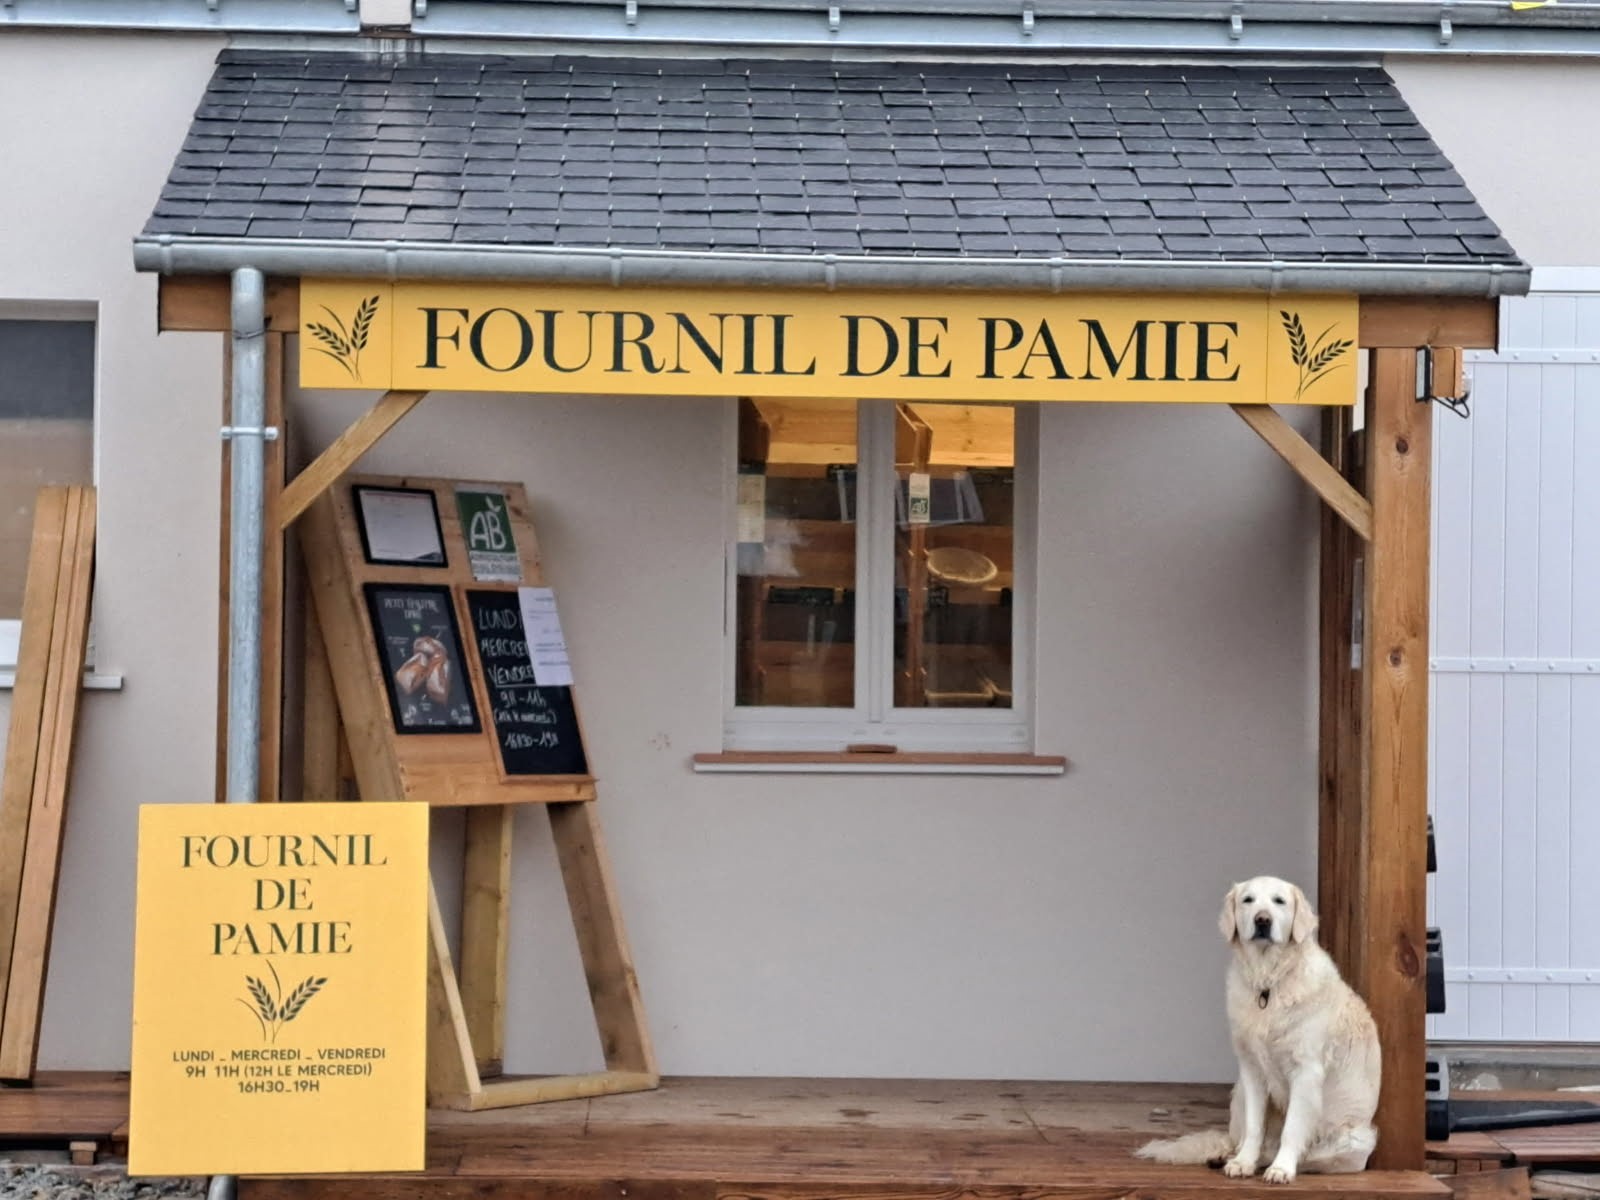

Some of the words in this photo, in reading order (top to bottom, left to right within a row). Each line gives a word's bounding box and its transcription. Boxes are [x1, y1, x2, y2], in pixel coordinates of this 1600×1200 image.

[416, 306, 816, 375] FOURNIL
[838, 315, 952, 378] DE
[976, 317, 1241, 382] PAMIE
[470, 511, 506, 549] AB
[480, 639, 529, 656] MERCRE
[487, 664, 535, 686] VENDRE
[183, 834, 389, 869] FOURNIL
[254, 879, 313, 912] DE
[211, 921, 353, 956] PAMIE
[172, 1051, 215, 1062] LUNDI
[231, 1049, 301, 1061] MERCREDI
[317, 1048, 386, 1060] VENDREDI
[185, 1066, 206, 1078] 9H
[215, 1066, 240, 1077] 11H
[244, 1065, 273, 1078] (12H
[277, 1065, 292, 1077] LE
[297, 1063, 372, 1077] MERCREDI)
